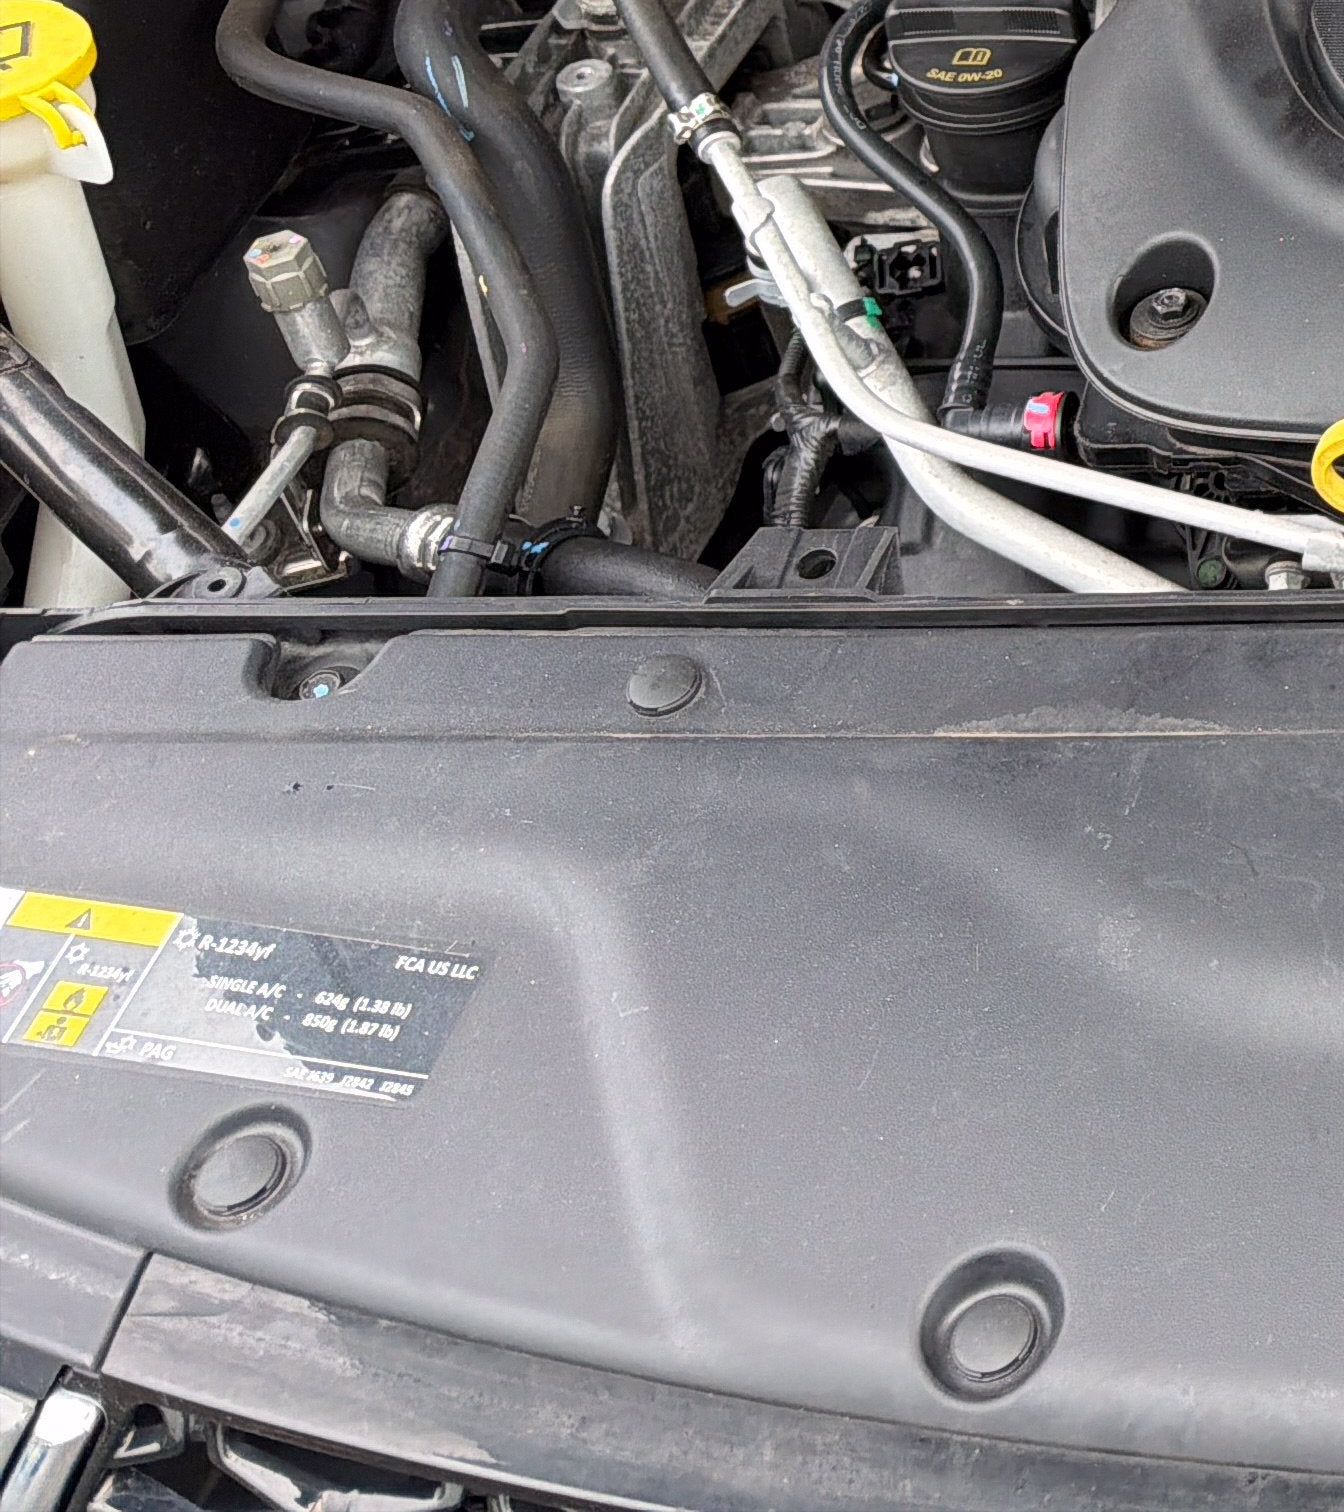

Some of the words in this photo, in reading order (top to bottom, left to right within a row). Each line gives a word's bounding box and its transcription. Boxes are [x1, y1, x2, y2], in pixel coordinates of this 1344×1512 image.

[926, 68, 957, 82] SAE
[957, 68, 1003, 82] 0W-20
[198, 934, 277, 962] R-1234yf
[395, 954, 426, 973] FCA
[427, 959, 450, 976] US
[450, 963, 480, 980] LLC
[206, 974, 258, 995] SINGLE
[256, 982, 287, 999] A/C
[314, 990, 350, 1010] 624g
[352, 995, 391, 1015] (1.38
[204, 998, 248, 1017] DUAL
[246, 1004, 275, 1021] A/C
[302, 1013, 338, 1033] 850g
[139, 1041, 177, 1061] PAG
